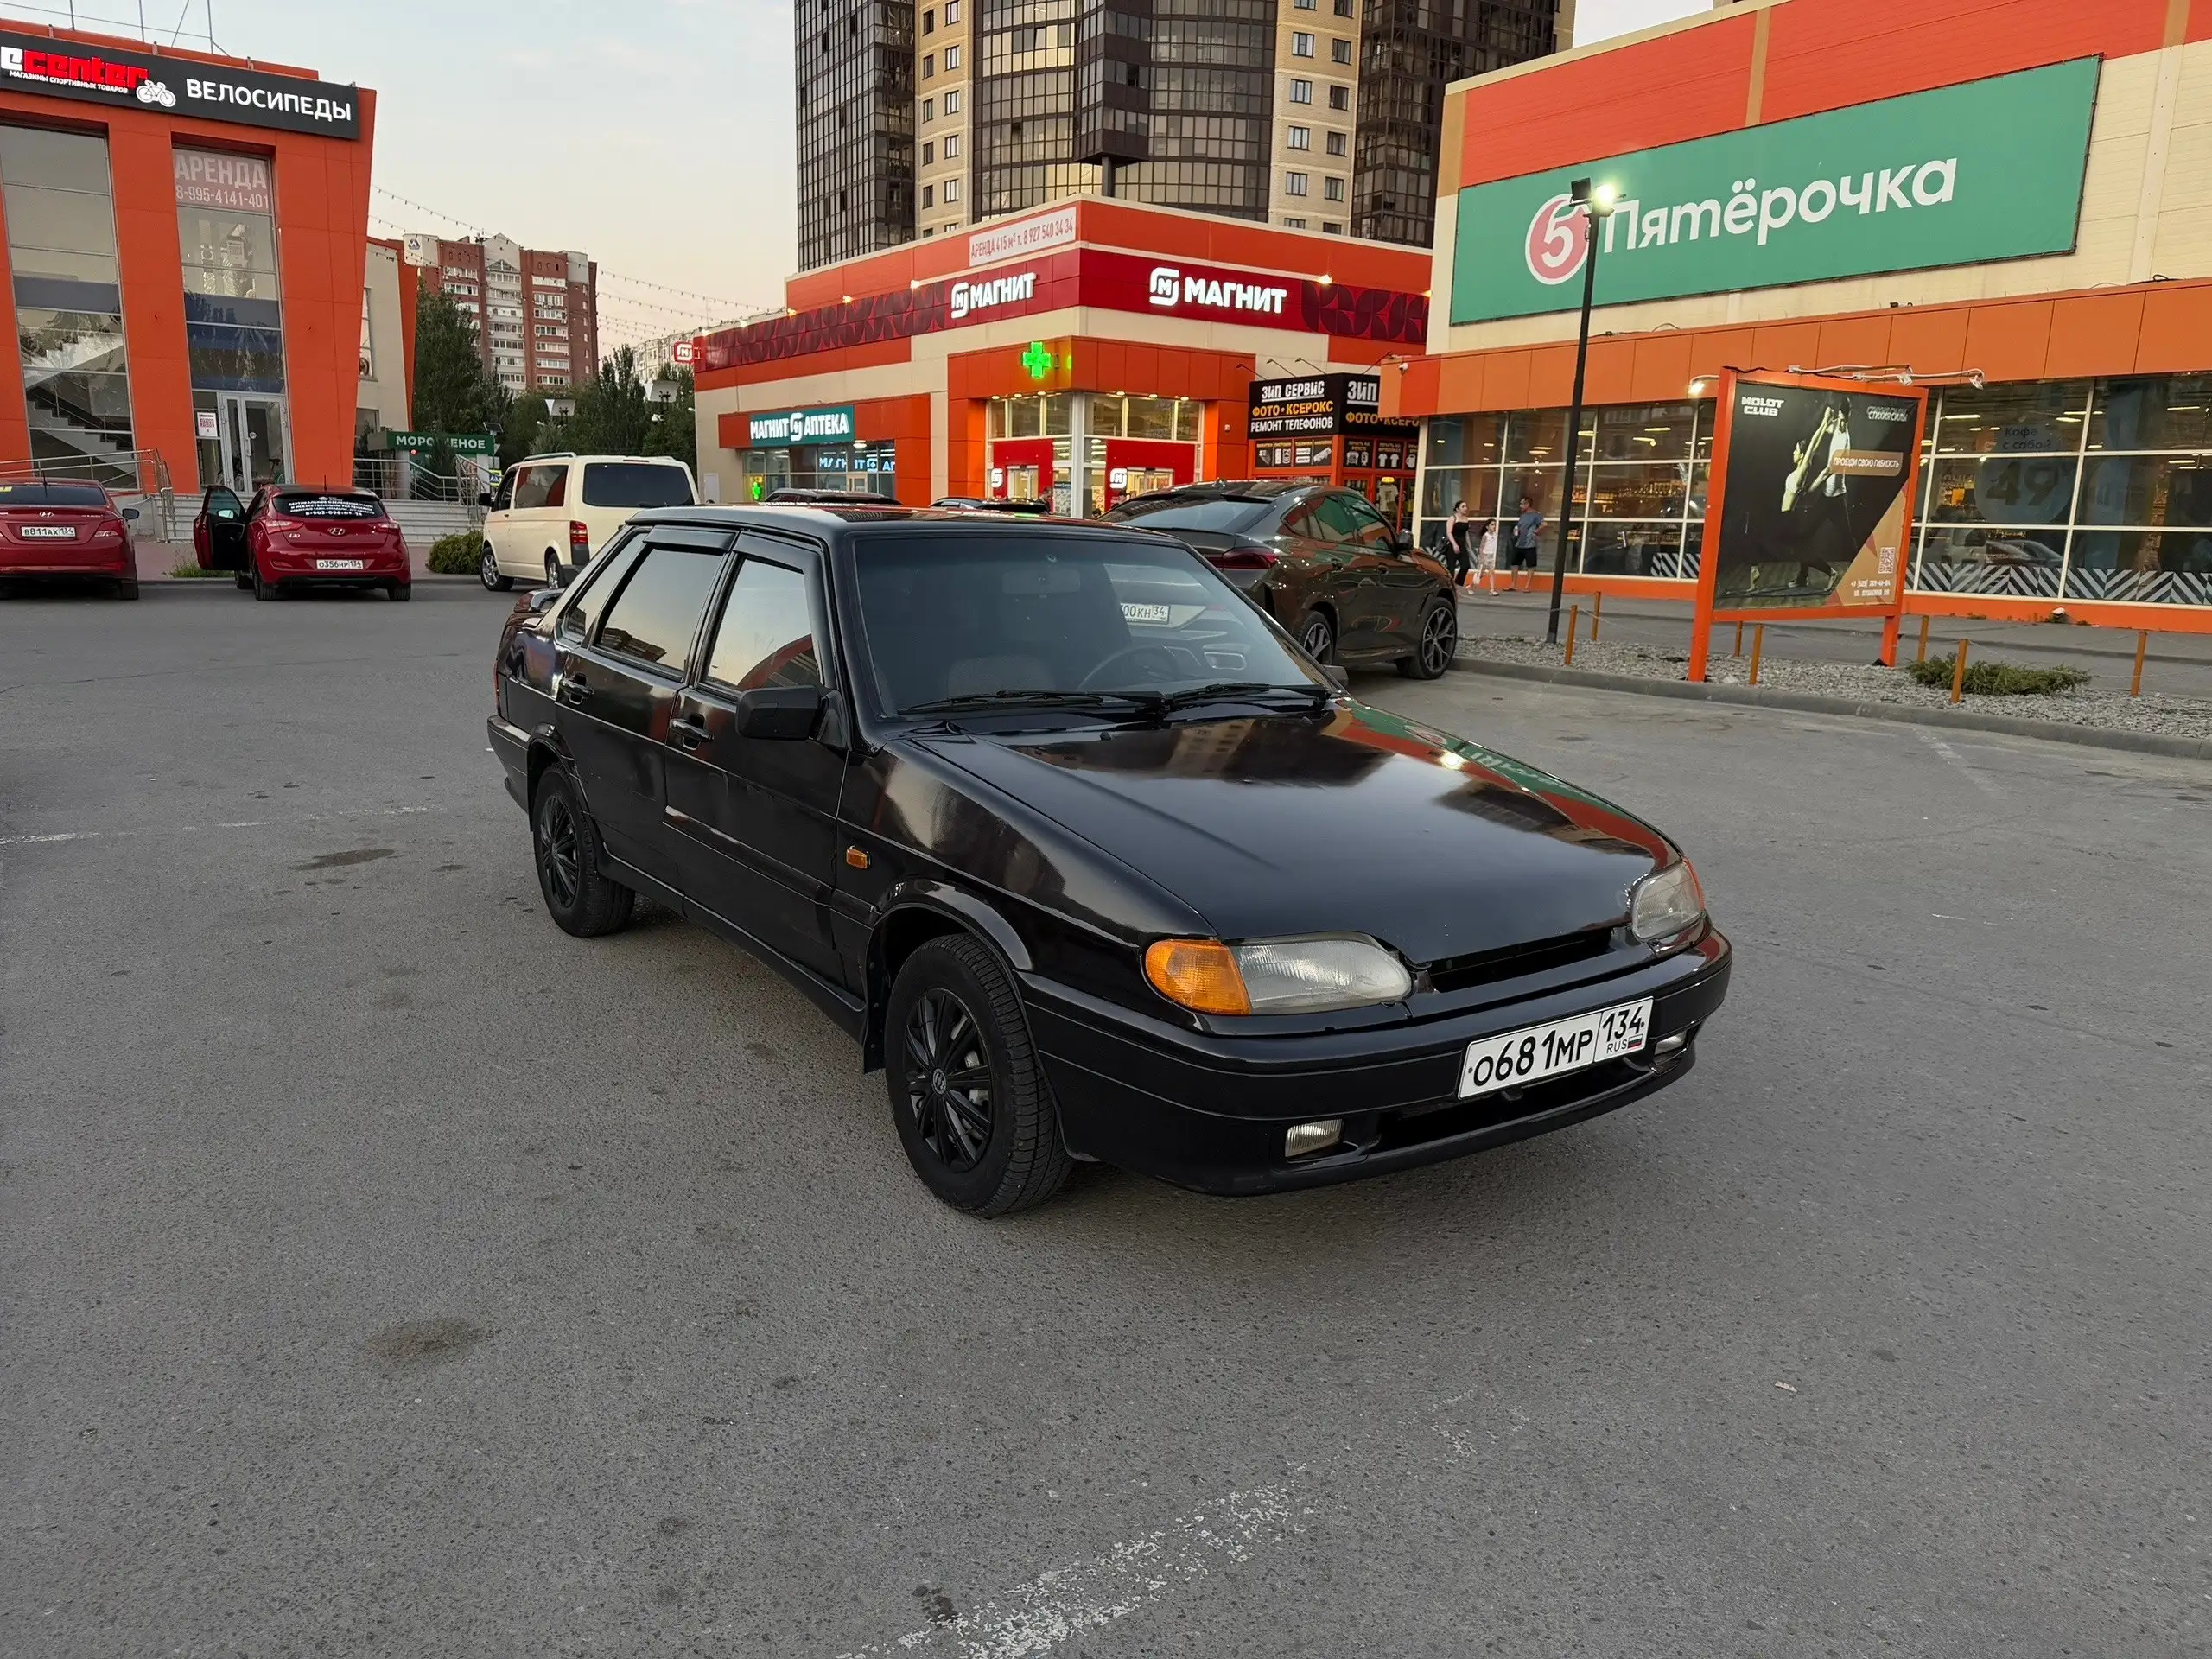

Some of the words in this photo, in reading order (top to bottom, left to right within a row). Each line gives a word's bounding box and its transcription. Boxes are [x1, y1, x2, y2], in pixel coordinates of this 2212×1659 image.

[9, 70, 48, 82] МАГАЗИНЫ
[49, 76, 97, 89] СПОРТИВНЫХ
[97, 83, 129, 94] ТОВАРОВ
[186, 78, 352, 122] ВЕЛОСИПЕДЫ
[175, 154, 267, 190] АРЕНДА
[175, 186, 269, 209] 8-995-4141-401
[1602, 157, 1959, 254] Пятёрочка
[971, 238, 995, 258] АРЕНДА
[996, 235, 1007, 251] 415
[1023, 229, 1027, 245] 8
[1028, 226, 1041, 244] 927
[1041, 222, 1054, 239] 540
[1055, 220, 1064, 236] 34
[1065, 217, 1073, 233] 34
[970, 271, 1037, 309] МАГНИТ
[1185, 276, 1287, 314] МАГНИТ
[1262, 385, 1282, 399] ЗИП
[1285, 380, 1325, 397] СЕРВИС
[1347, 380, 1377, 401] ЗИП
[1252, 404, 1280, 416] ФОТО
[1286, 400, 1333, 415] КСЕРОКС
[1741, 396, 1785, 408] MOLOT
[1744, 405, 1778, 416] CLUB
[750, 417, 790, 440] МАГНИТ
[804, 412, 850, 436] АПТЕКА
[1250, 420, 1282, 432] РЕМОНТ
[1285, 416, 1333, 430] ТЕЛЕФОНОВ
[1345, 411, 1378, 424] ФОТО
[396, 435, 486, 449] МОРОЕНОЕ
[2005, 426, 2038, 438] Кофе
[1154, 606, 1166, 616] 34
[1602, 1006, 1643, 1042] 134
[1606, 1038, 1628, 1055] RUS
